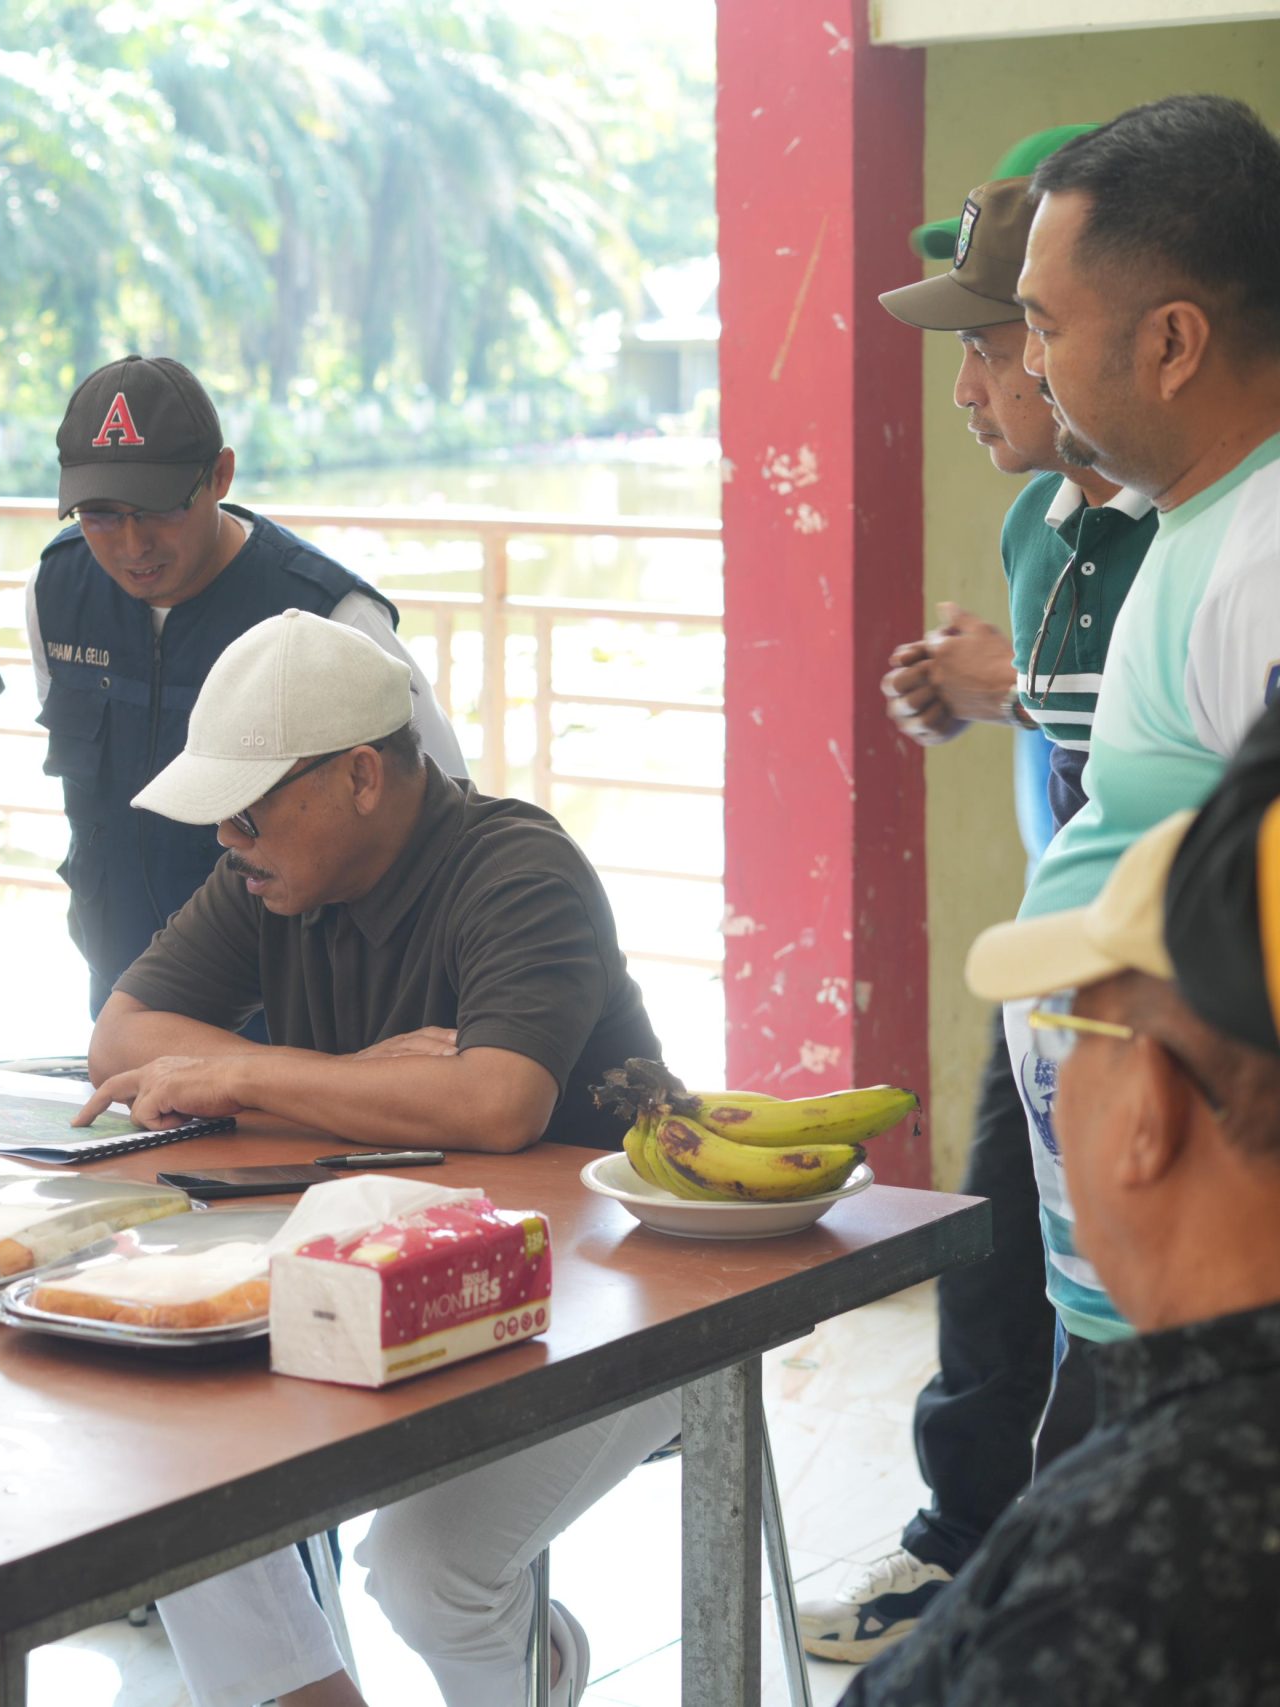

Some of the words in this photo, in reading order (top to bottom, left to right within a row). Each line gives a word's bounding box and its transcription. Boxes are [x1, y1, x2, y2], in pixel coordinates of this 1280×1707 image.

[92, 391, 145, 447] A
[75, 646, 84, 663] A.
[85, 647, 110, 667] GELLO
[240, 729, 265, 747] alo
